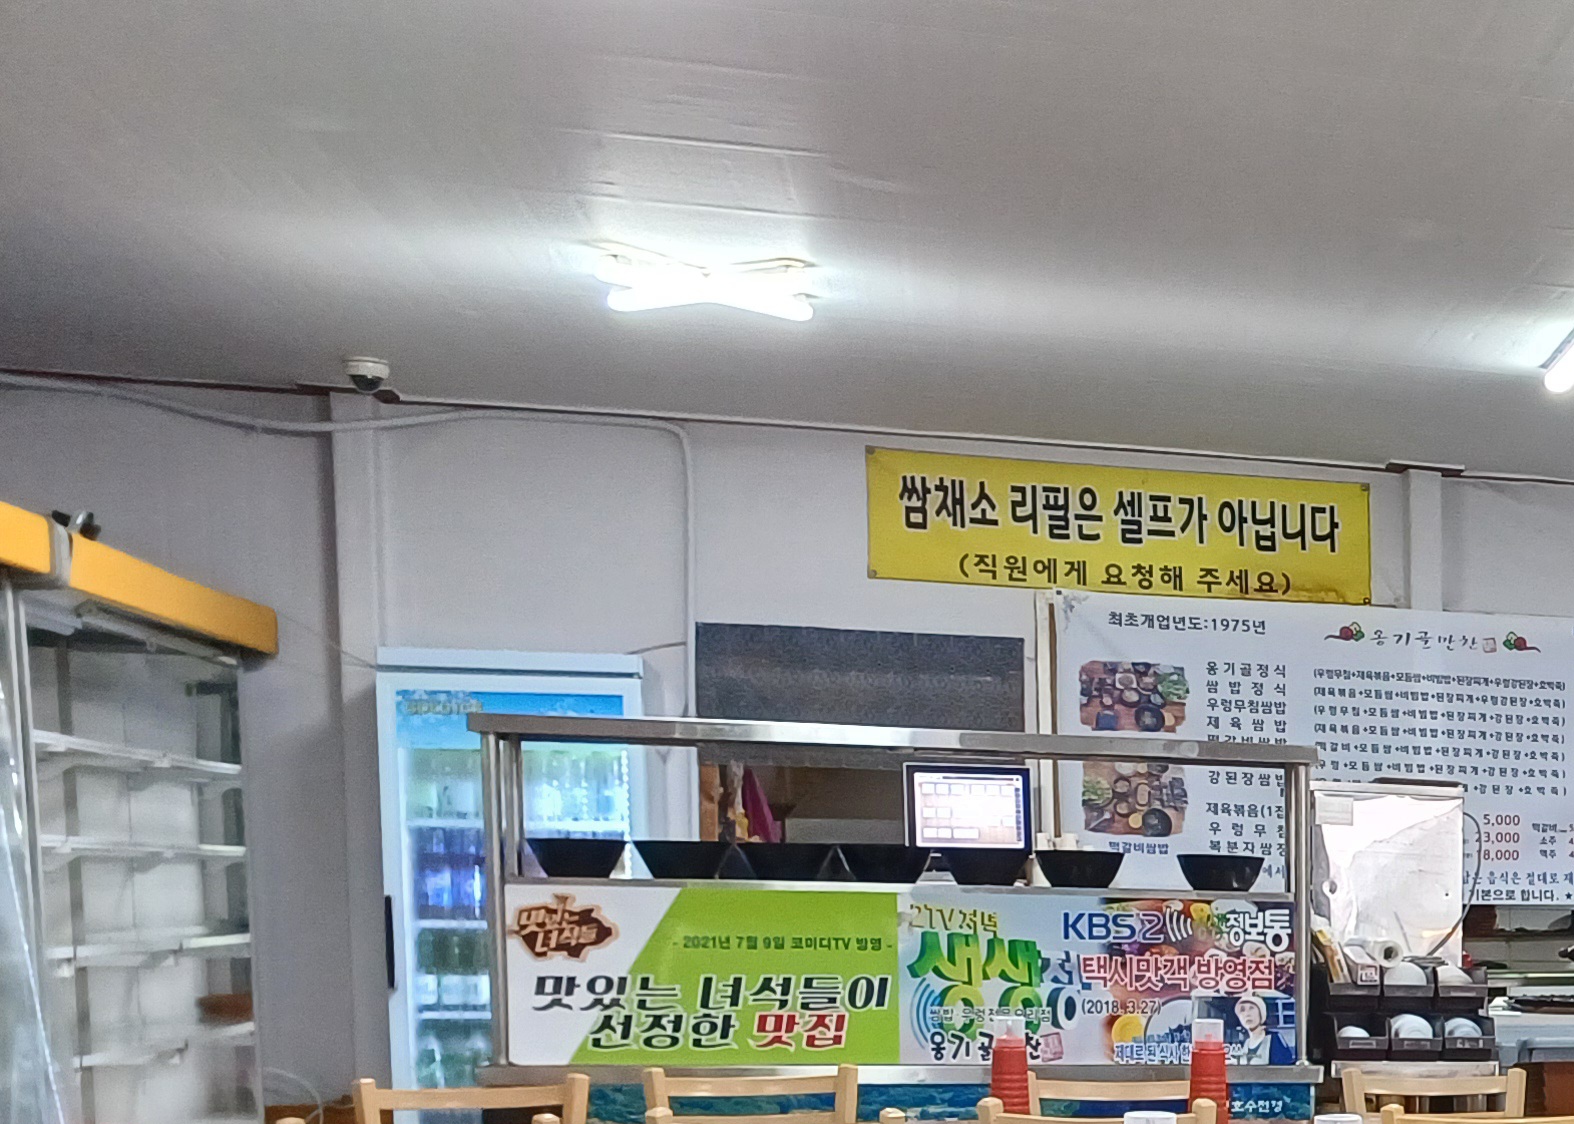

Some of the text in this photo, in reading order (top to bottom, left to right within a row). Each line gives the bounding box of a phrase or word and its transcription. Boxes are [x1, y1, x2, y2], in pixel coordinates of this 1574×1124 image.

[899, 473, 1340, 553] 쌈채소 리필은 셀프가 아닙니다
[959, 552, 1291, 597] (직원에게 요청해 주세요)
[682, 935, 731, 950] 2021년
[790, 936, 852, 950] 코미디TV
[1063, 908, 1293, 952] KBS2 정보통
[1082, 955, 1275, 992] 택시맛객 방영점
[532, 974, 891, 1012] 맛있는 녀석들이
[1081, 999, 1122, 1015] (2018.
[589, 1012, 847, 1049] 선정한 맛집
